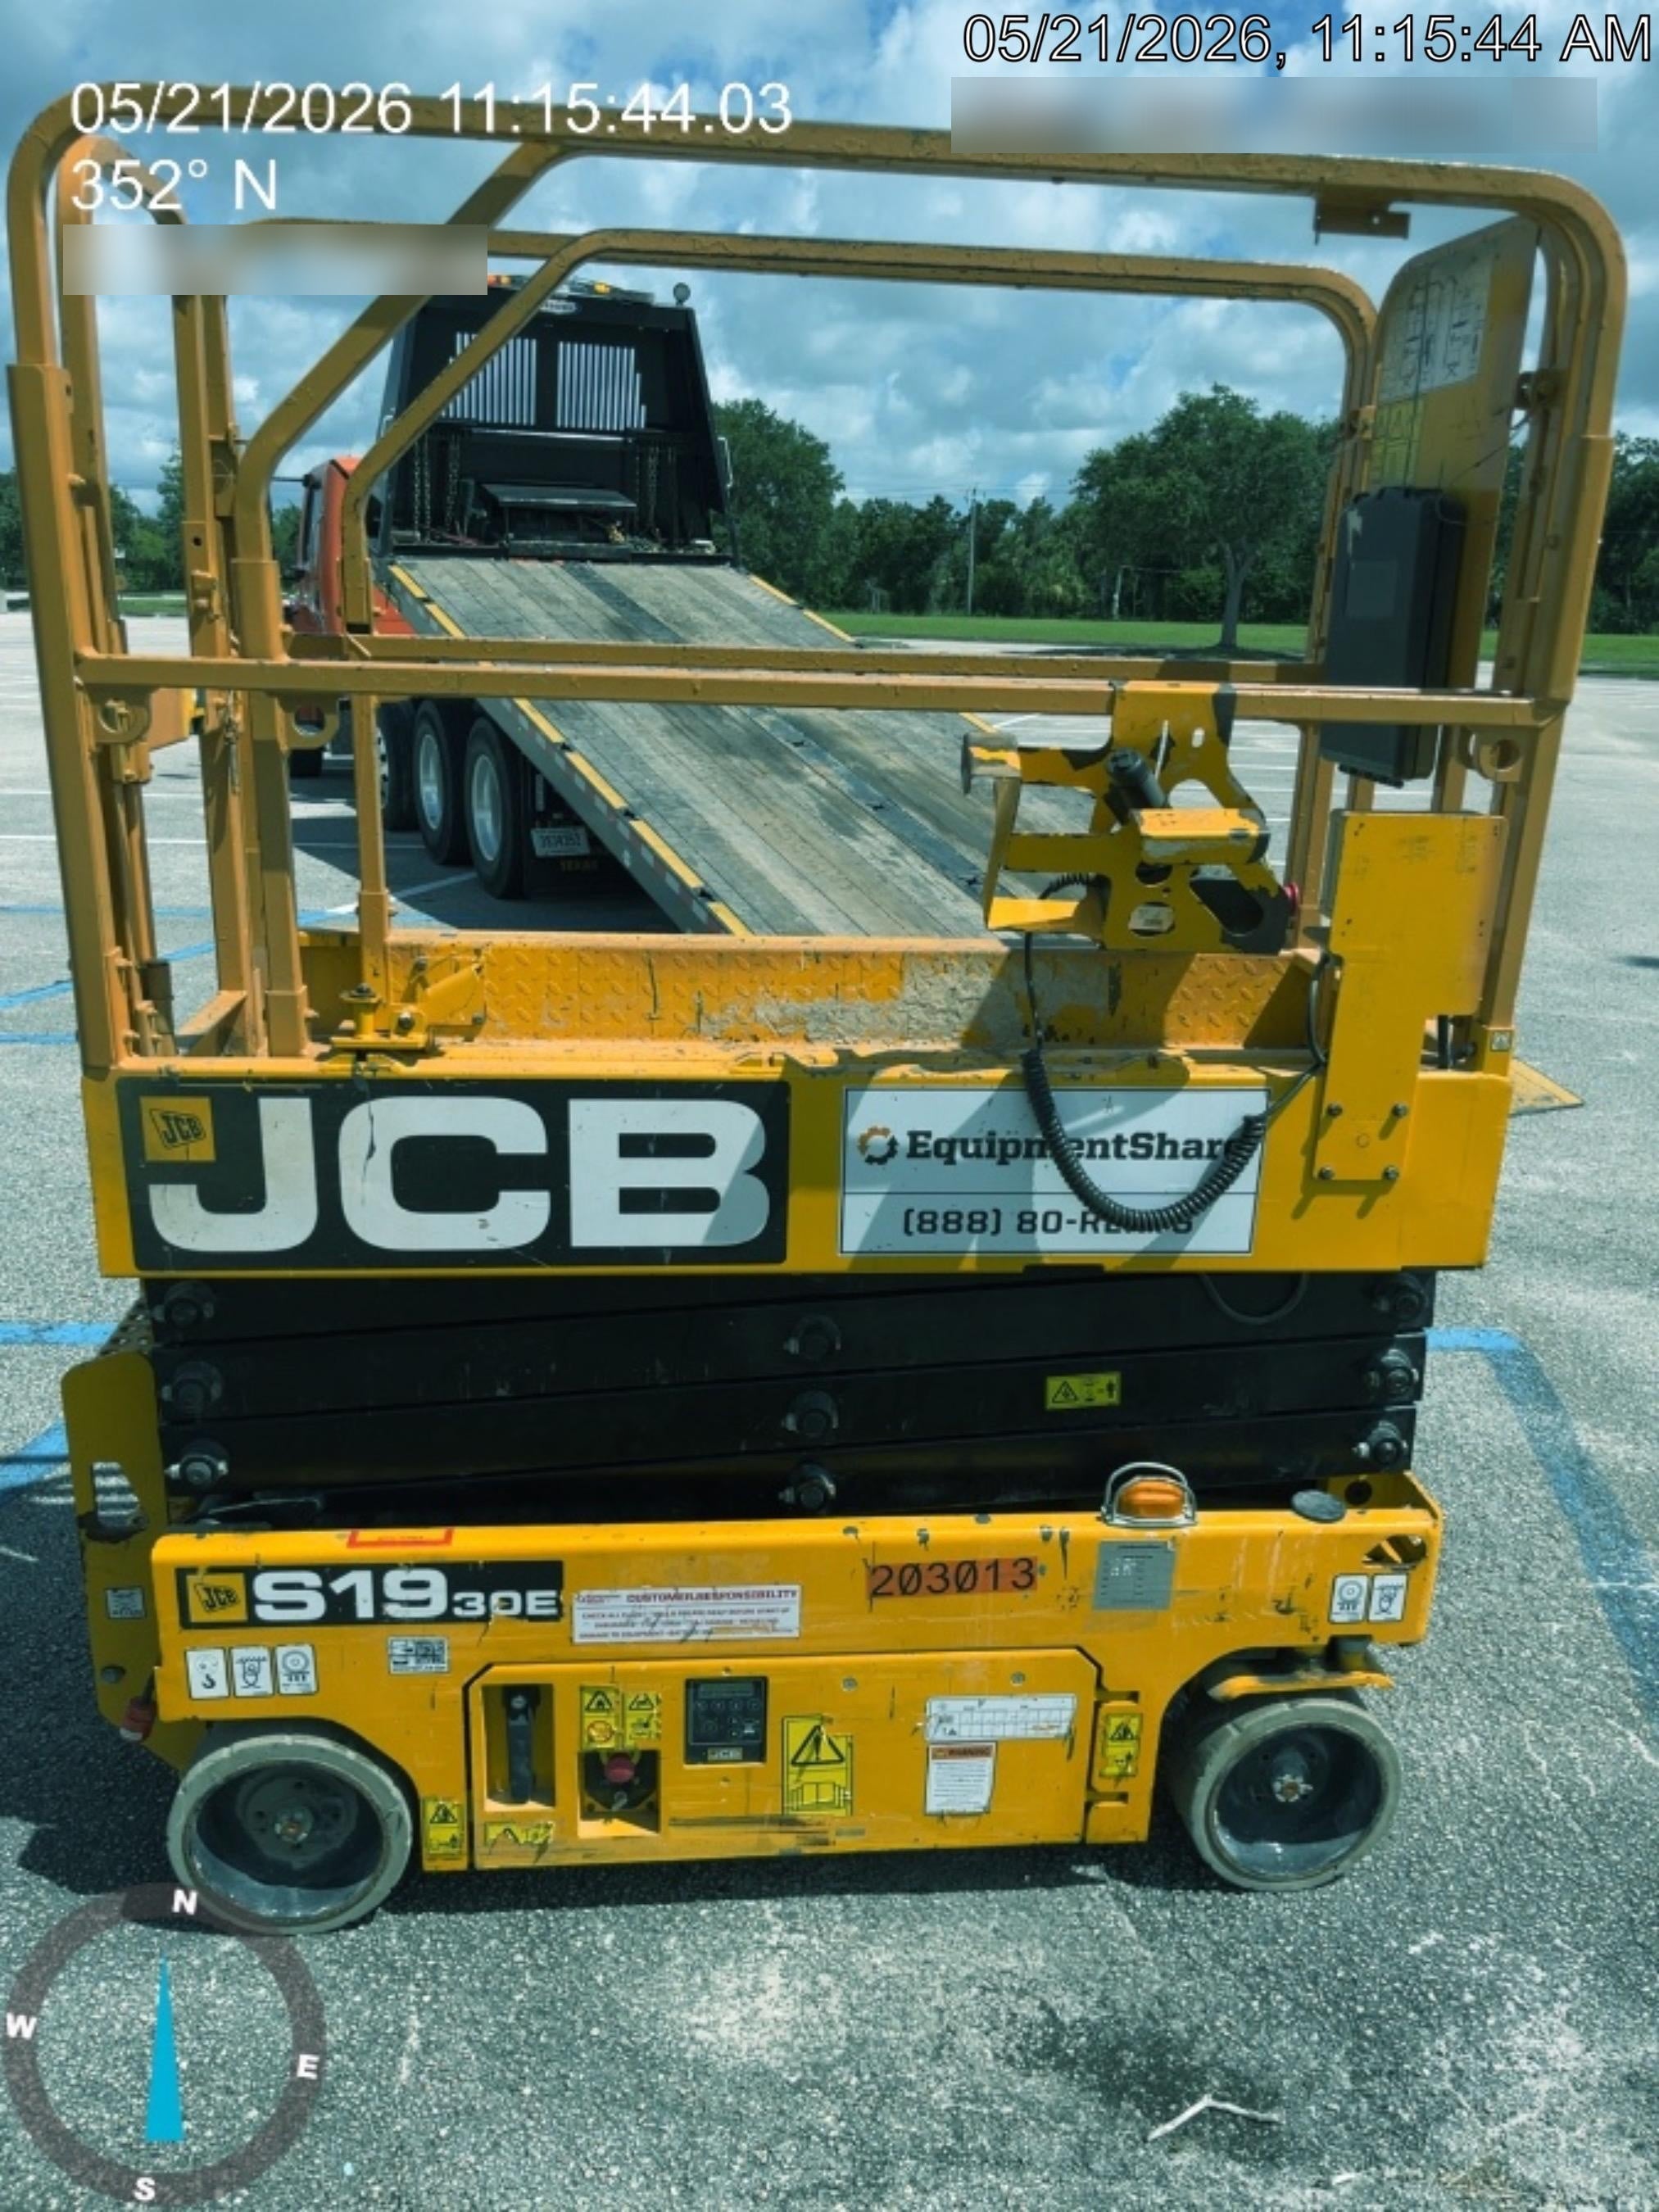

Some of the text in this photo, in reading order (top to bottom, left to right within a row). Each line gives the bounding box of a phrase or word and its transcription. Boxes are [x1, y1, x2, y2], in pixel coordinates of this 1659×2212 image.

[157, 1111, 205, 1145] JCB
[906, 1130, 1240, 1166] EquipmentShar
[148, 1095, 771, 1253] JCB
[903, 1208, 1002, 1236] (888)
[870, 1557, 1036, 1597] 203013
[199, 1586, 239, 1610] JCB
